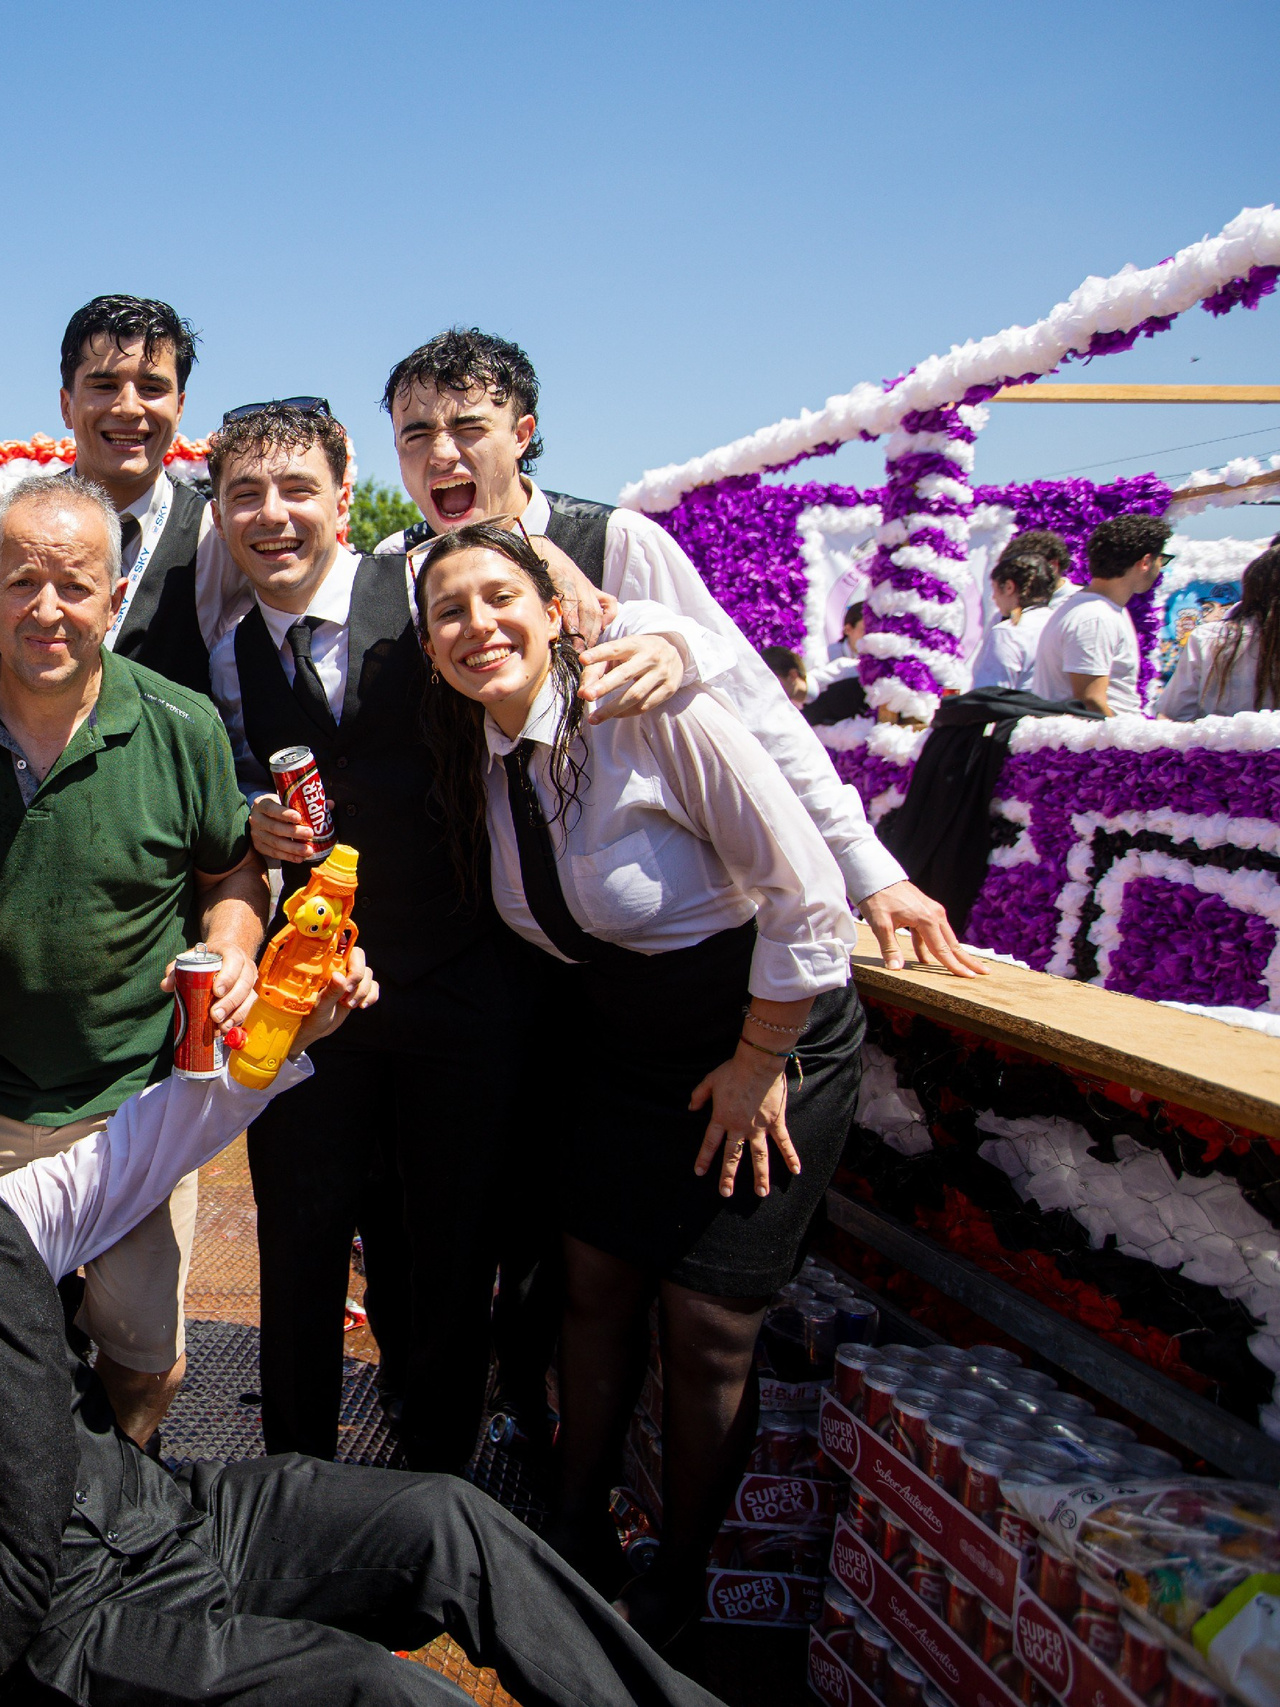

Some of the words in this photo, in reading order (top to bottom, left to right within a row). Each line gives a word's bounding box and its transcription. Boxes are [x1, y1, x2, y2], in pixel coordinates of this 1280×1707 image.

[156, 501, 167, 526] SKY
[134, 547, 150, 573] SKY
[116, 598, 129, 623] SKY
[302, 780, 328, 835] SUPER
[822, 1416, 854, 1439] SUPER
[825, 1434, 854, 1455] BOCK
[872, 1459, 902, 1490] Sabor
[744, 1481, 805, 1507] SUPER
[752, 1495, 808, 1521] BOCK
[836, 1543, 867, 1573] SUPER
[839, 1561, 869, 1587] BOCK
[716, 1578, 776, 1604] SUPER
[724, 1592, 779, 1618] BOCK
[888, 1596, 917, 1628] Sabor
[1019, 1616, 1063, 1655] SUPER
[811, 1653, 844, 1685] SUPER
[1023, 1639, 1064, 1676] BOCK
[814, 1671, 846, 1701] BOCK
